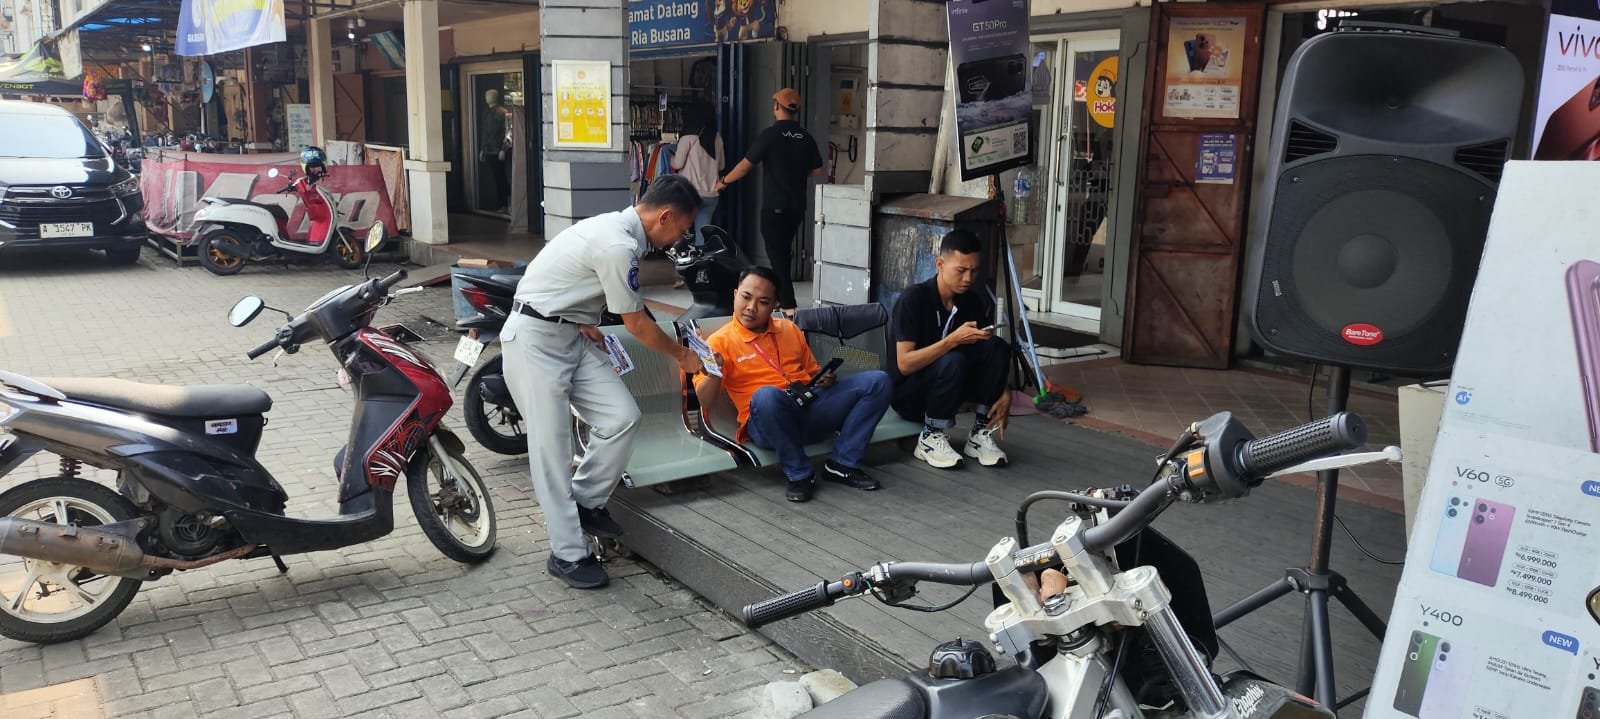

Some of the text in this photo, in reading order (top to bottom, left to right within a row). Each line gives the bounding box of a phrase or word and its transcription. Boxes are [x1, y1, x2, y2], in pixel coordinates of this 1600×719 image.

[657, 1, 698, 19] Datang
[632, 27, 690, 45] Ria Busana
[81, 224, 91, 232] PK
[1456, 466, 1511, 486] V60 5G
[1420, 605, 1463, 626] Y400
[1549, 634, 1573, 648] NEW
